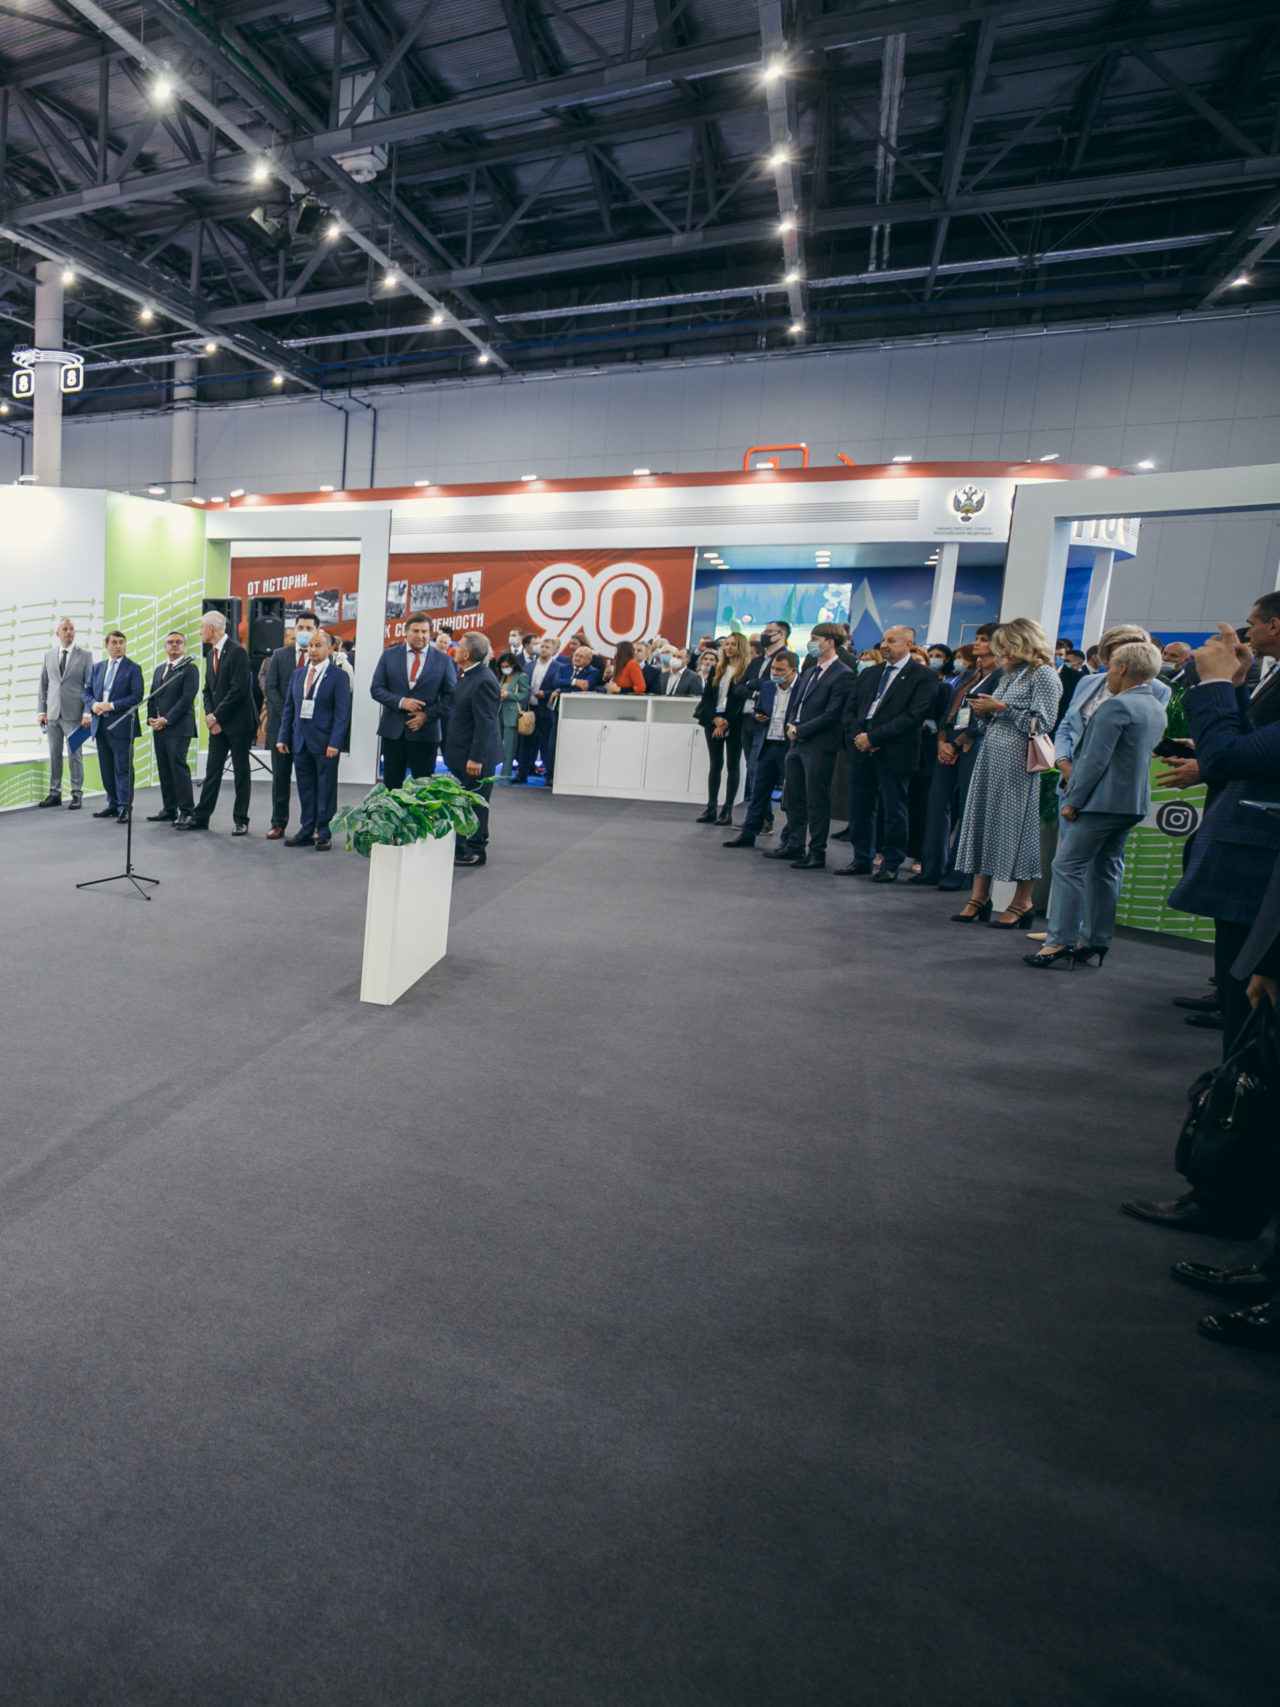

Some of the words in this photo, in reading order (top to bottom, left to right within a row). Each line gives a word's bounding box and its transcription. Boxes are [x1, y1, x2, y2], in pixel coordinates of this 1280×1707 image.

[18, 375, 29, 392] 8
[66, 369, 77, 387] 8
[247, 580, 261, 596] ОТ
[262, 573, 318, 594] ИСТОРИИ...
[525, 562, 664, 660] 90
